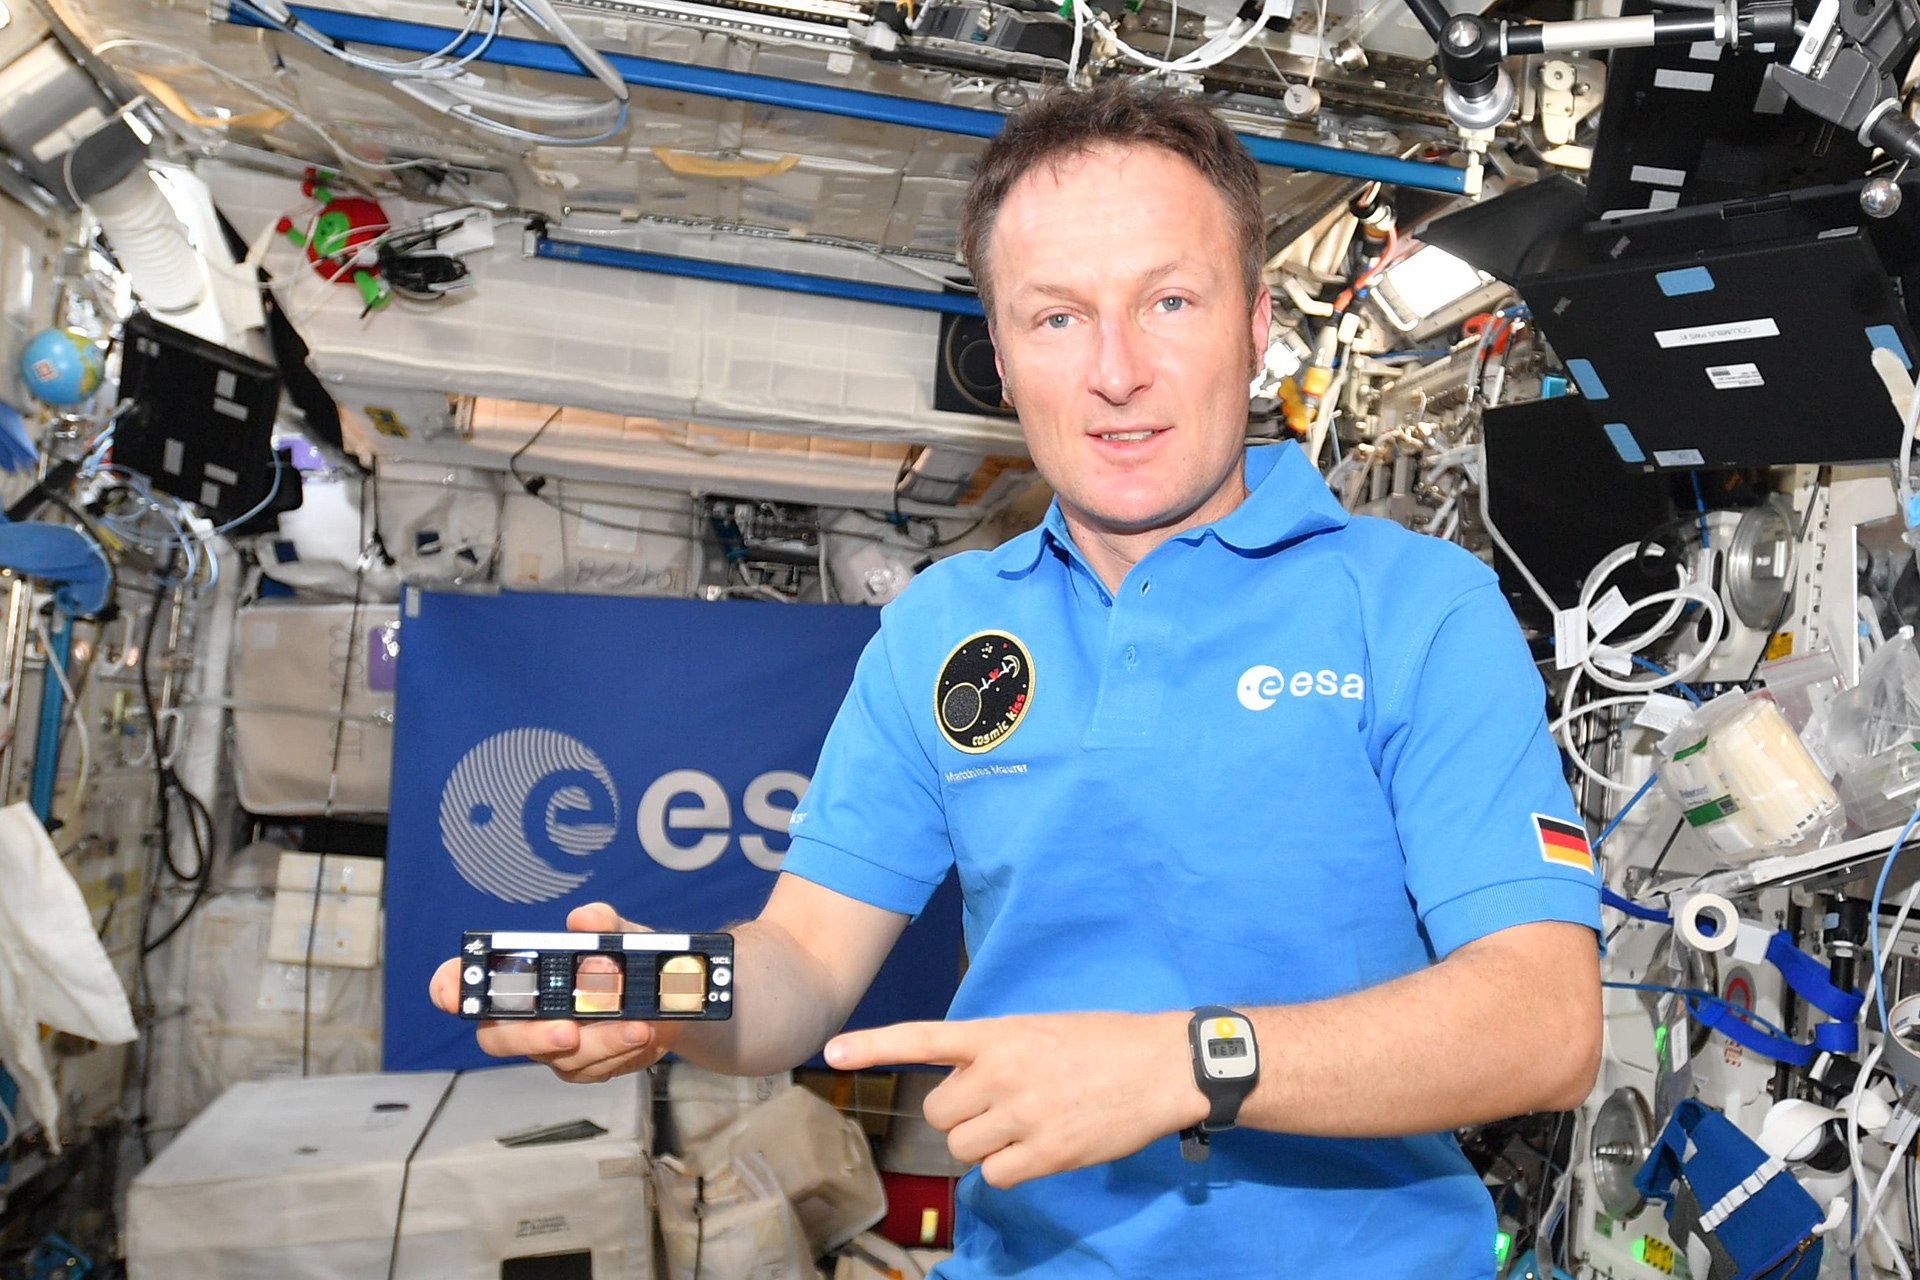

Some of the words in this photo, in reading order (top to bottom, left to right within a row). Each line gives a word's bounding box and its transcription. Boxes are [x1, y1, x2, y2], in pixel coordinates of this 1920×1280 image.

[1708, 327, 1752, 338] COLUMBUS
[1289, 669, 1365, 701] esa
[972, 720, 1010, 746] cosmic
[1005, 693, 1026, 721] kiss
[944, 767, 990, 783] Matthias
[991, 763, 1028, 777] Maurer
[712, 956, 731, 965] UCL
